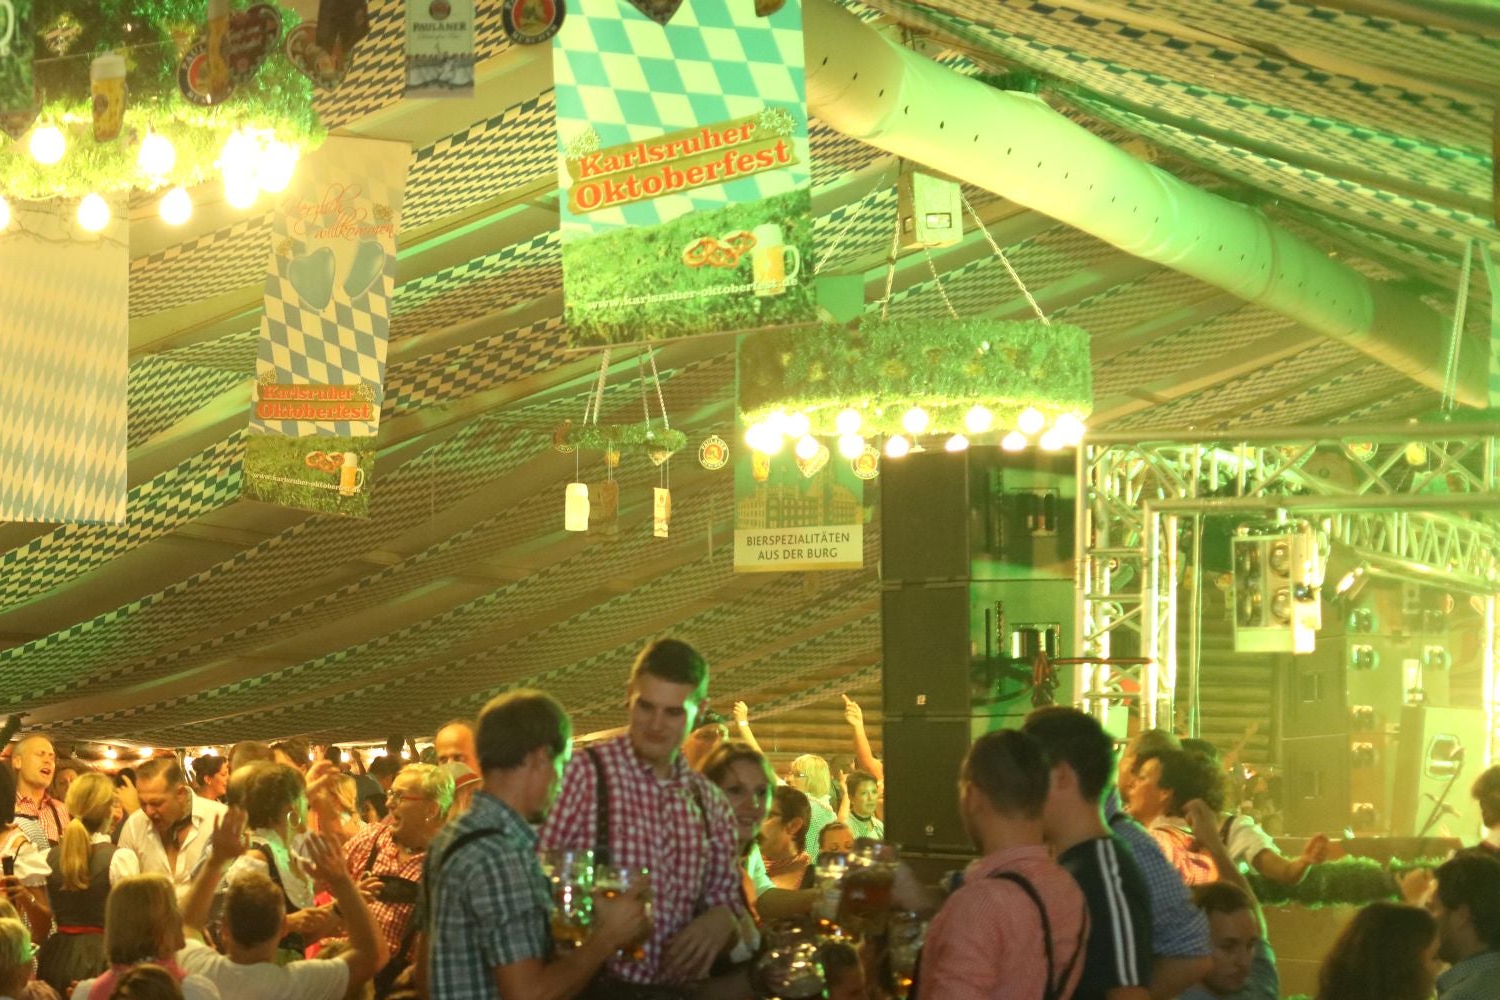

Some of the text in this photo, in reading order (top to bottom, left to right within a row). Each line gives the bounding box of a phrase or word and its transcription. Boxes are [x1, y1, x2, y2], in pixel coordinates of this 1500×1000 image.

[413, 22, 466, 32] PAULANER
[579, 122, 755, 180] Karlsruher
[575, 139, 791, 210] Oktoberfest
[589, 277, 798, 309] www.karlsruher-oktoberfest.de
[263, 385, 355, 400] Karlsruher
[260, 403, 371, 419] Oktoberfest
[252, 473, 361, 493] www.karlsruher-oktoberfest.de
[746, 532, 850, 546] BIERSPEZIALITÄTEN
[758, 548, 838, 560] AUS DER BURG
